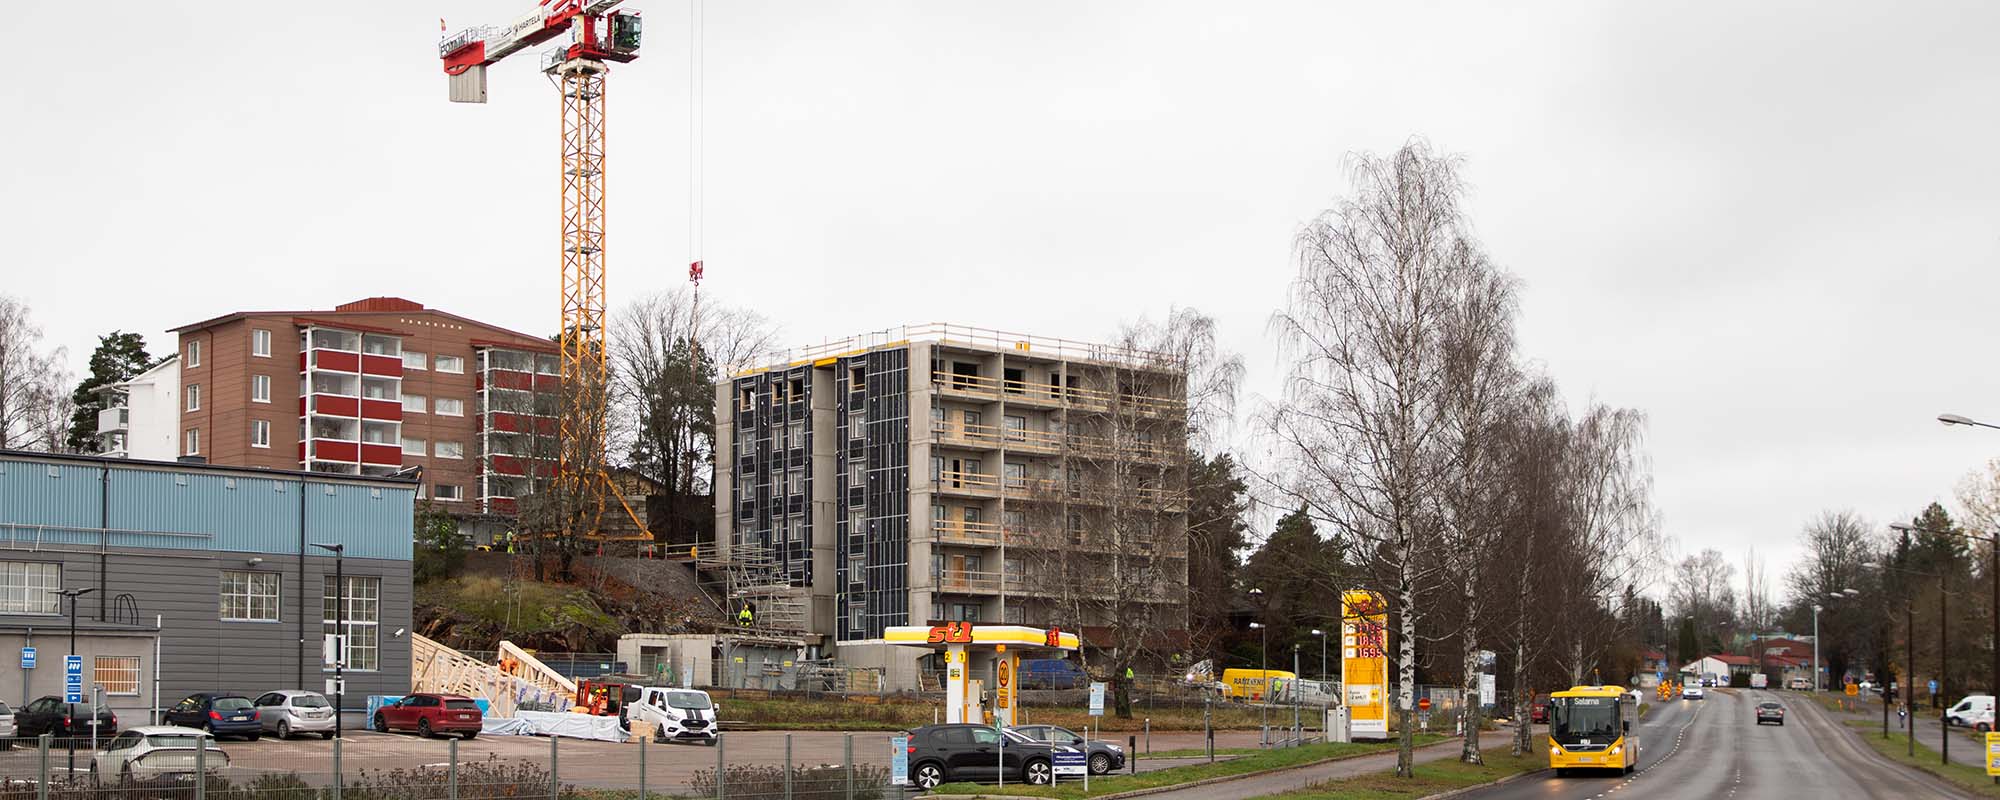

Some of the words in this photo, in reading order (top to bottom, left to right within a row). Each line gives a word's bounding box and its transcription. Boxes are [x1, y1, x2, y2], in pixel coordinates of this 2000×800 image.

[518, 14, 541, 32] HARTELA
[927, 621, 973, 643] st1
[1045, 626, 1060, 647] st1
[1000, 667, 1009, 680] 20
[1561, 698, 1566, 706] 1
